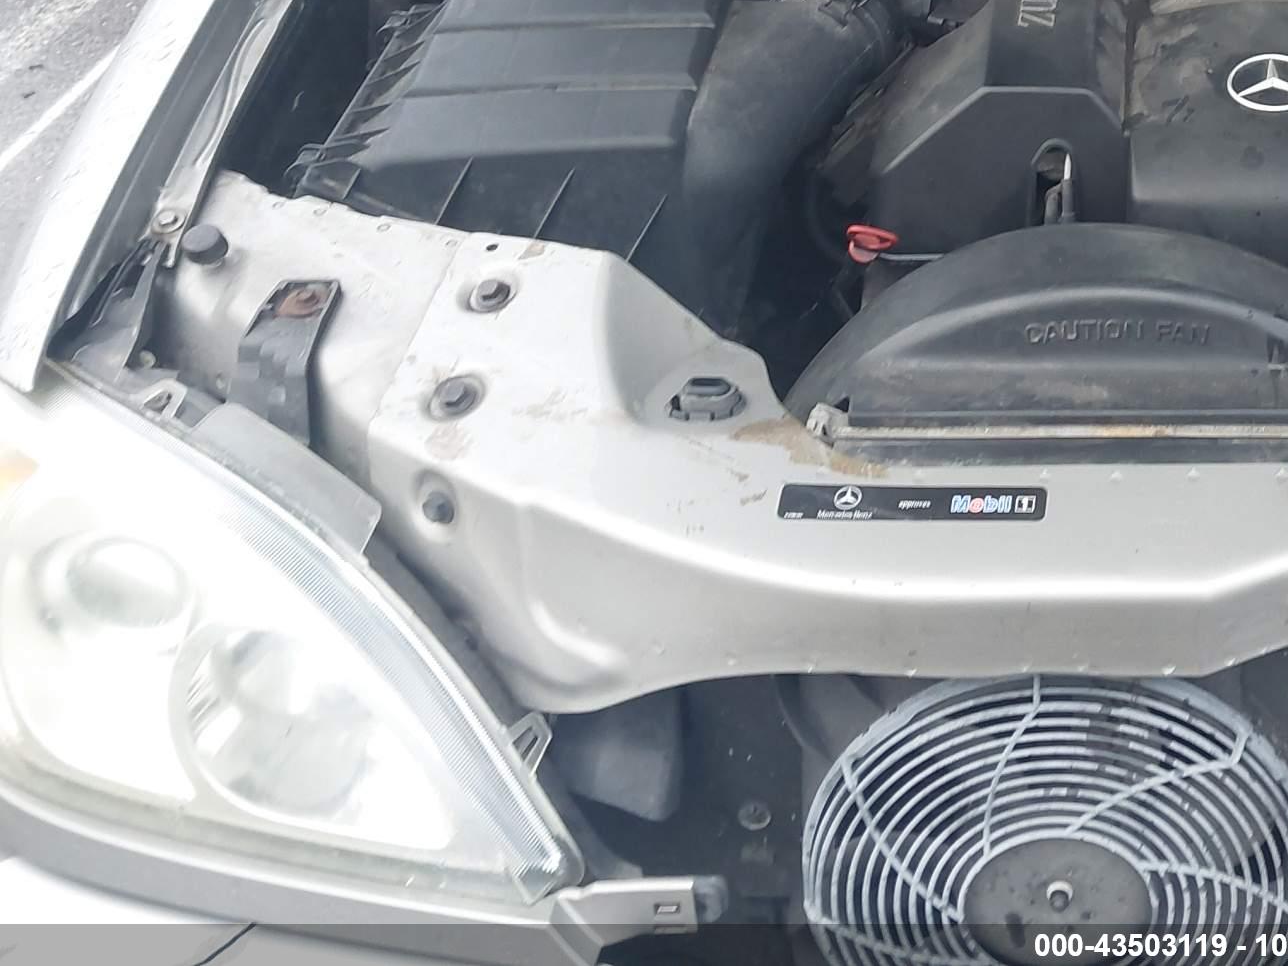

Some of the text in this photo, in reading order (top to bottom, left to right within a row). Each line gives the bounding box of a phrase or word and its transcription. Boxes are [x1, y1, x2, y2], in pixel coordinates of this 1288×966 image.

[1024, 318, 1211, 346] CAUTION FAN
[950, 495, 1012, 513] Mobil
